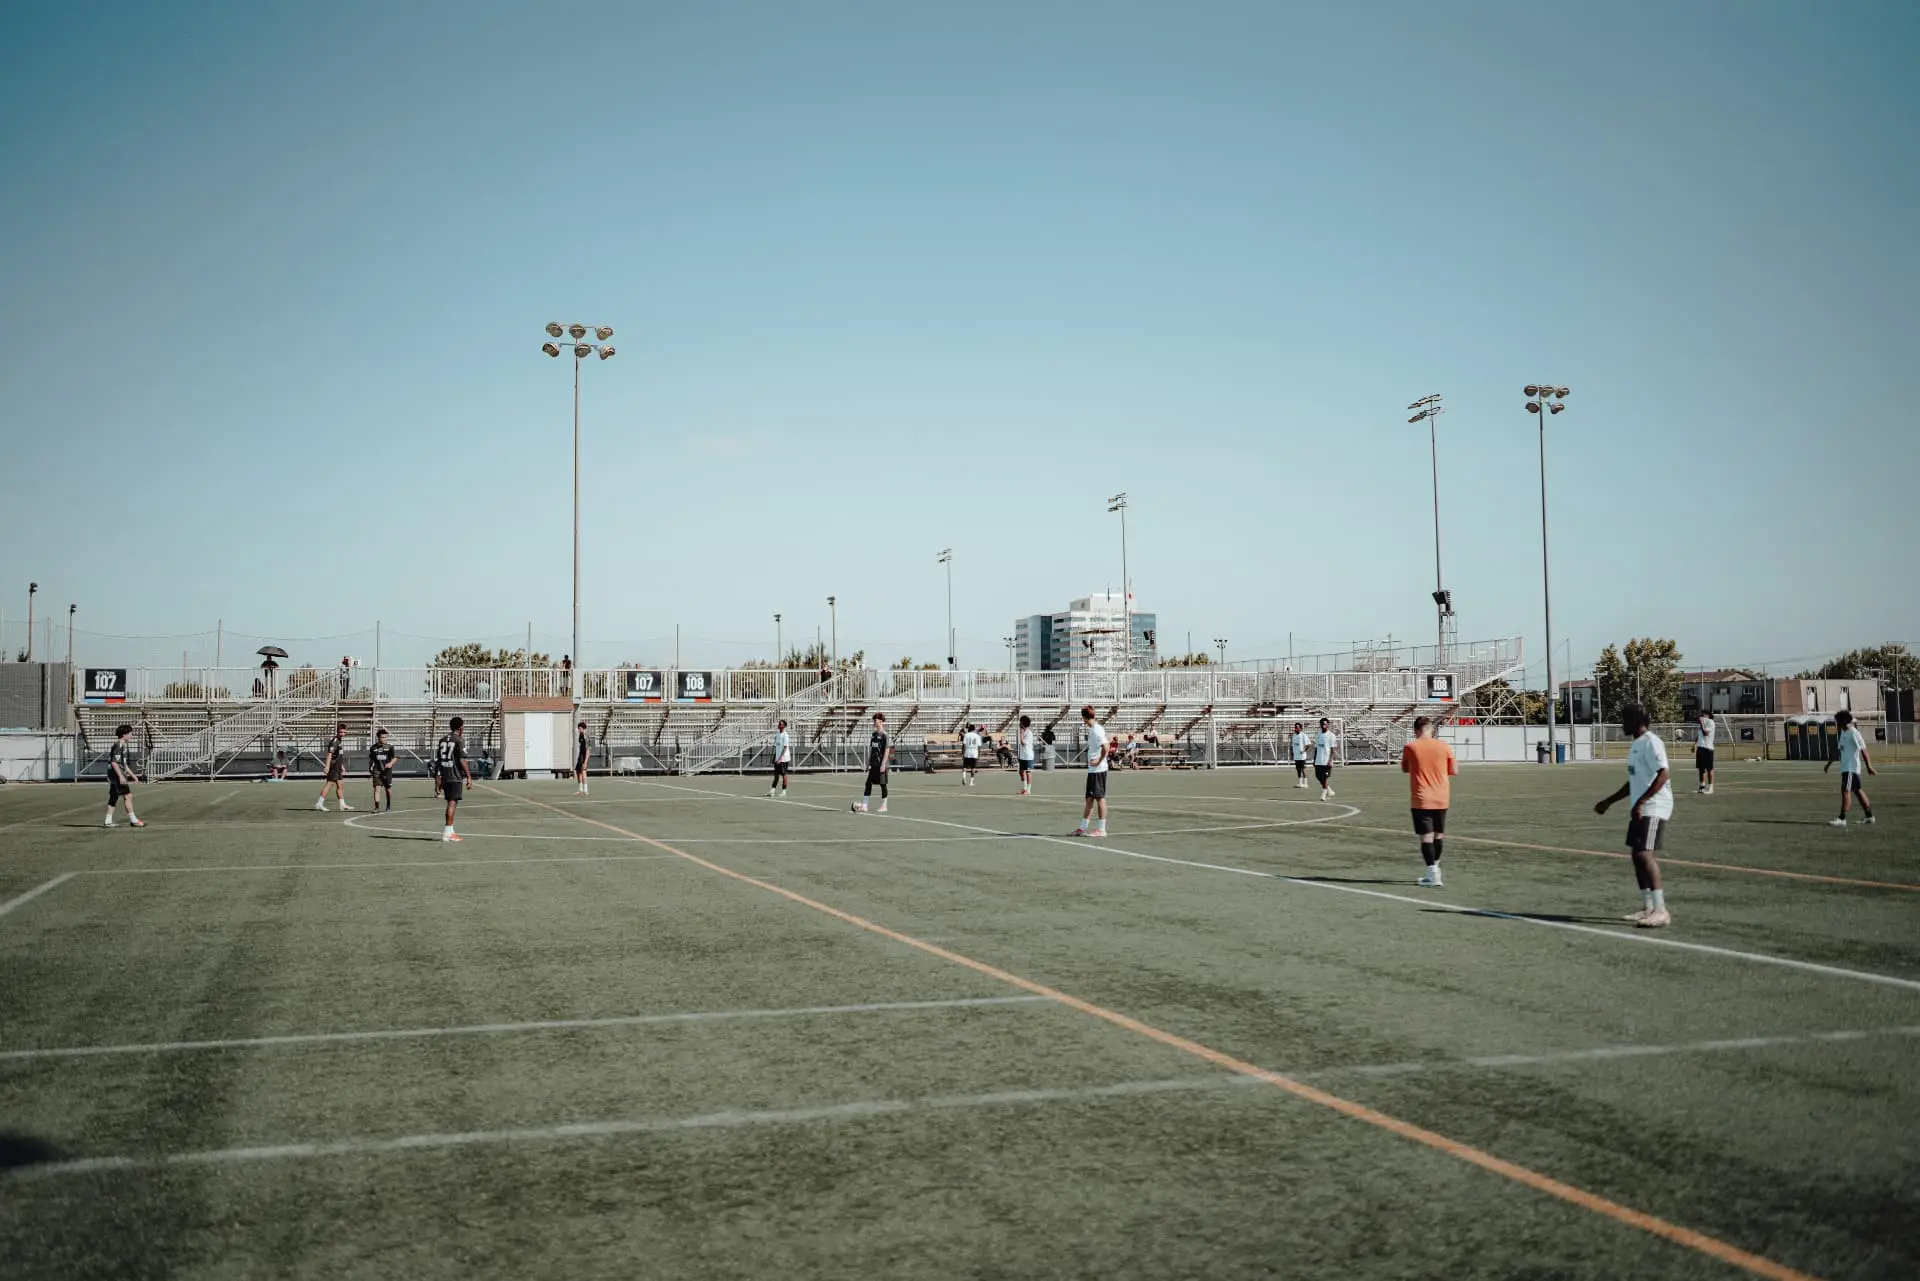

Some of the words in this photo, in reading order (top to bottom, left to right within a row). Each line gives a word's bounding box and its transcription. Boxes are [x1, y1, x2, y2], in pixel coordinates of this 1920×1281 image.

[95, 675, 116, 689] 107
[635, 677, 654, 690] 107
[686, 677, 704, 690] 108
[1433, 680, 1447, 691] 108
[440, 742, 455, 759] 27
